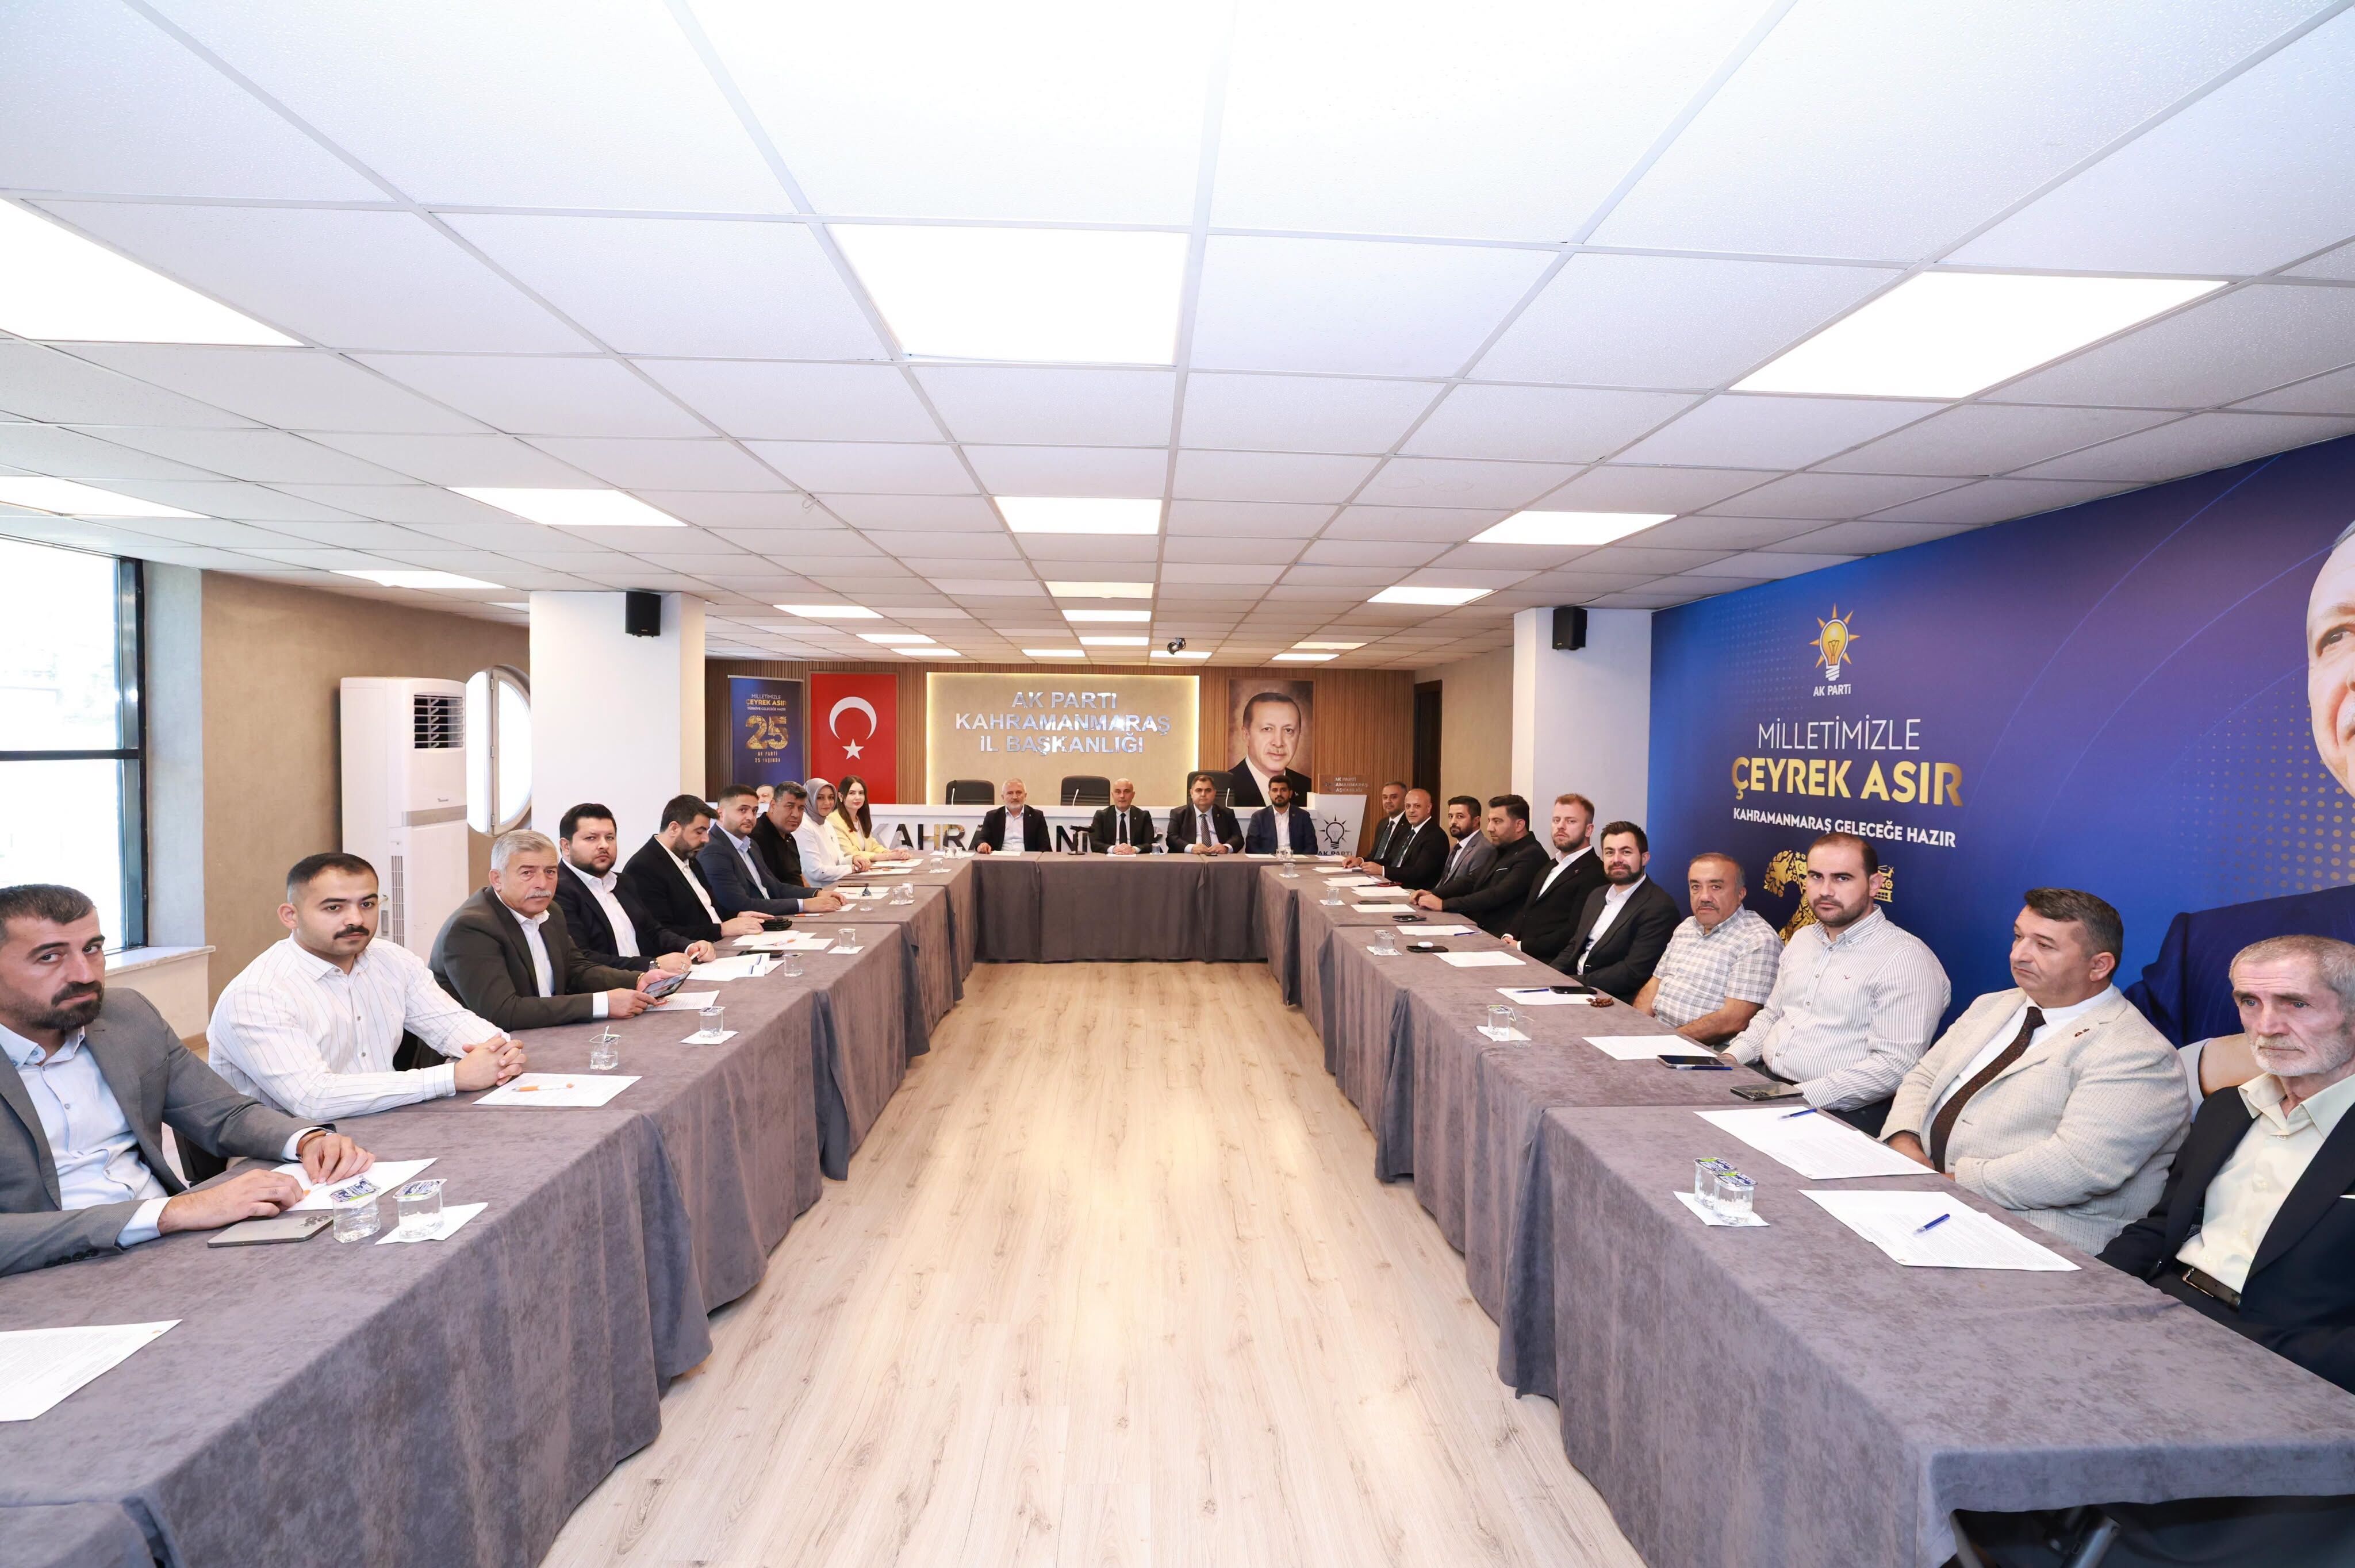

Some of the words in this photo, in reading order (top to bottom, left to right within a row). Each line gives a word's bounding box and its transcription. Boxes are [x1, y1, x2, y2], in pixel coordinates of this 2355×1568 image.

[1011, 691, 1044, 708] AK
[1813, 686, 1825, 697] AK
[746, 715, 788, 750] 25
[956, 713, 1171, 735] KAHRAMANMARAŞ
[1758, 714, 1921, 750] MİLLETİMİZLE
[1006, 732, 1144, 756] BAŞKANLIĞI
[1731, 756, 1852, 800] ÇEYREK
[1860, 760, 1963, 806] ASIR
[1733, 807, 1832, 834] KAHRAMANMARAŞ
[1834, 820, 1903, 841] GELECEĞE
[1907, 827, 1957, 848] HAZIR
